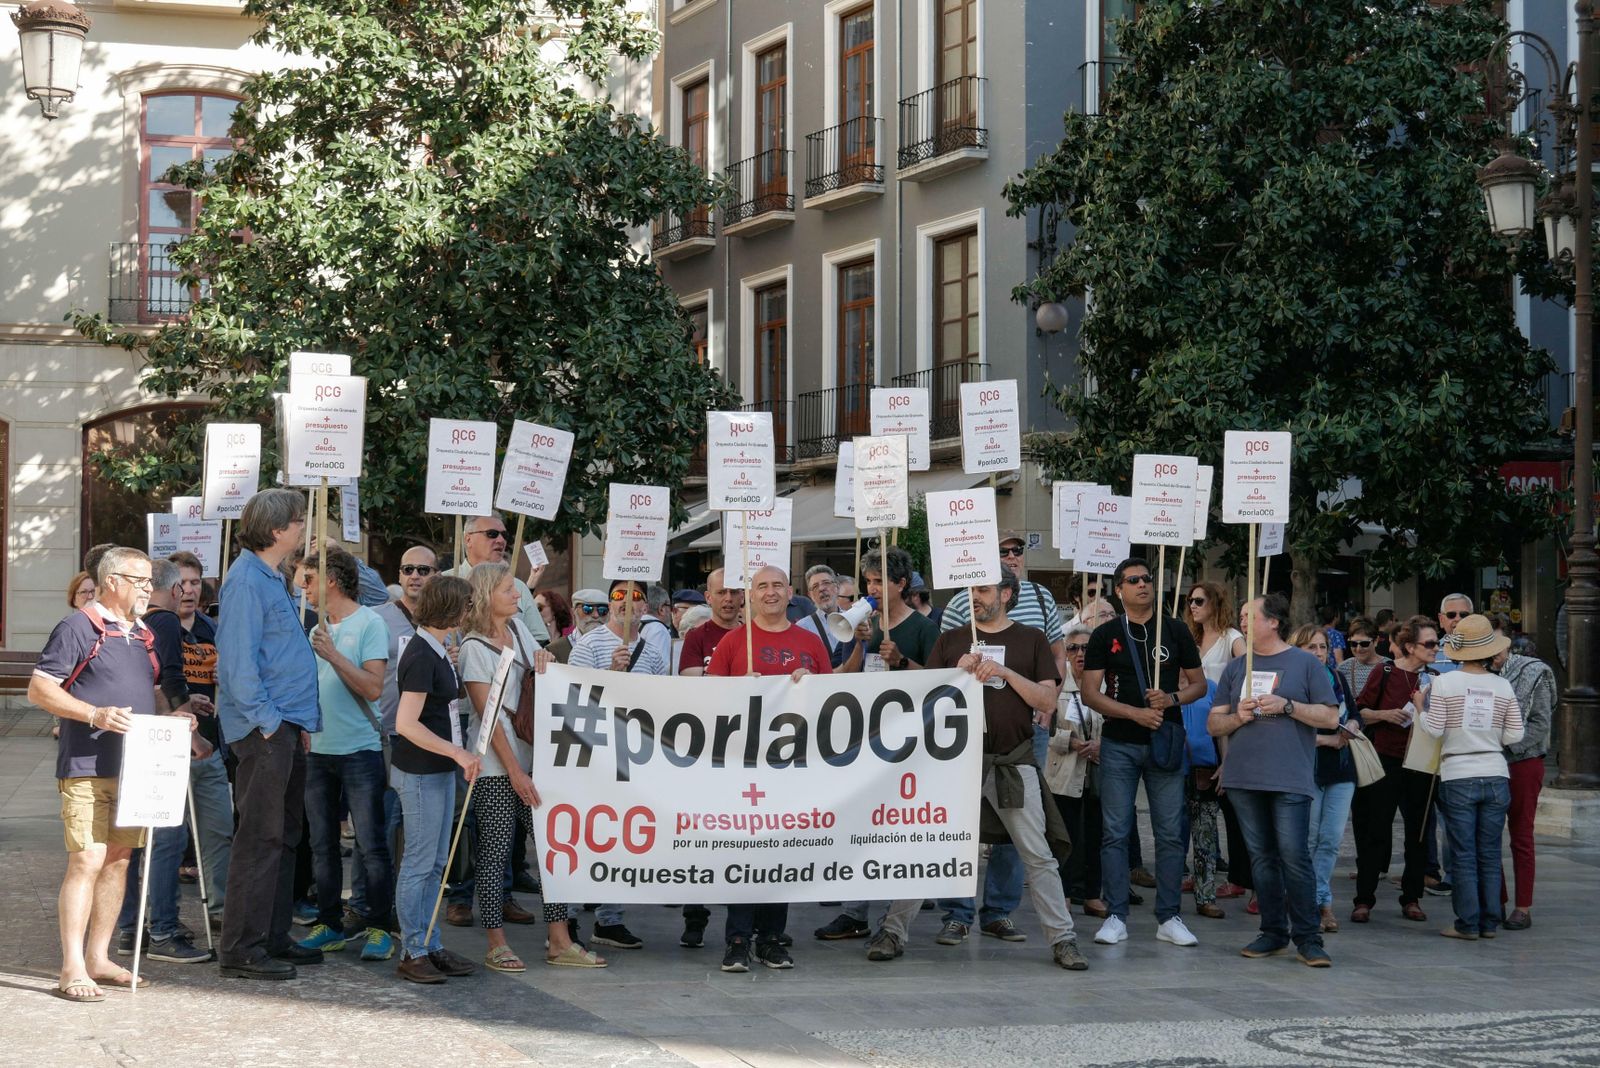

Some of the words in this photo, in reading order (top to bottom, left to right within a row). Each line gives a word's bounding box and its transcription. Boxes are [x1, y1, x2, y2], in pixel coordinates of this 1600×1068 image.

[305, 422, 348, 430] presupuesto
[305, 461, 345, 469] #porlaOCG
[442, 499, 478, 508] #porlaOCG
[944, 535, 984, 544] presupuesto
[949, 571, 986, 581] #porlaOCG
[550, 682, 969, 782] #porlaOCG
[899, 772, 917, 800] 0
[676, 807, 835, 836] presupuesto
[872, 802, 948, 826] deuda
[673, 839, 692, 850] por
[695, 839, 708, 848] un
[711, 837, 780, 851] presupuesto
[783, 836, 834, 848] adecuado
[850, 832, 906, 846] liquidación
[911, 833, 923, 843] de
[926, 832, 935, 842] la
[939, 831, 971, 842] deuda
[590, 862, 714, 887] Orquesta
[724, 862, 815, 884] Ciudad
[823, 862, 854, 881] de
[863, 858, 973, 880] Granada
